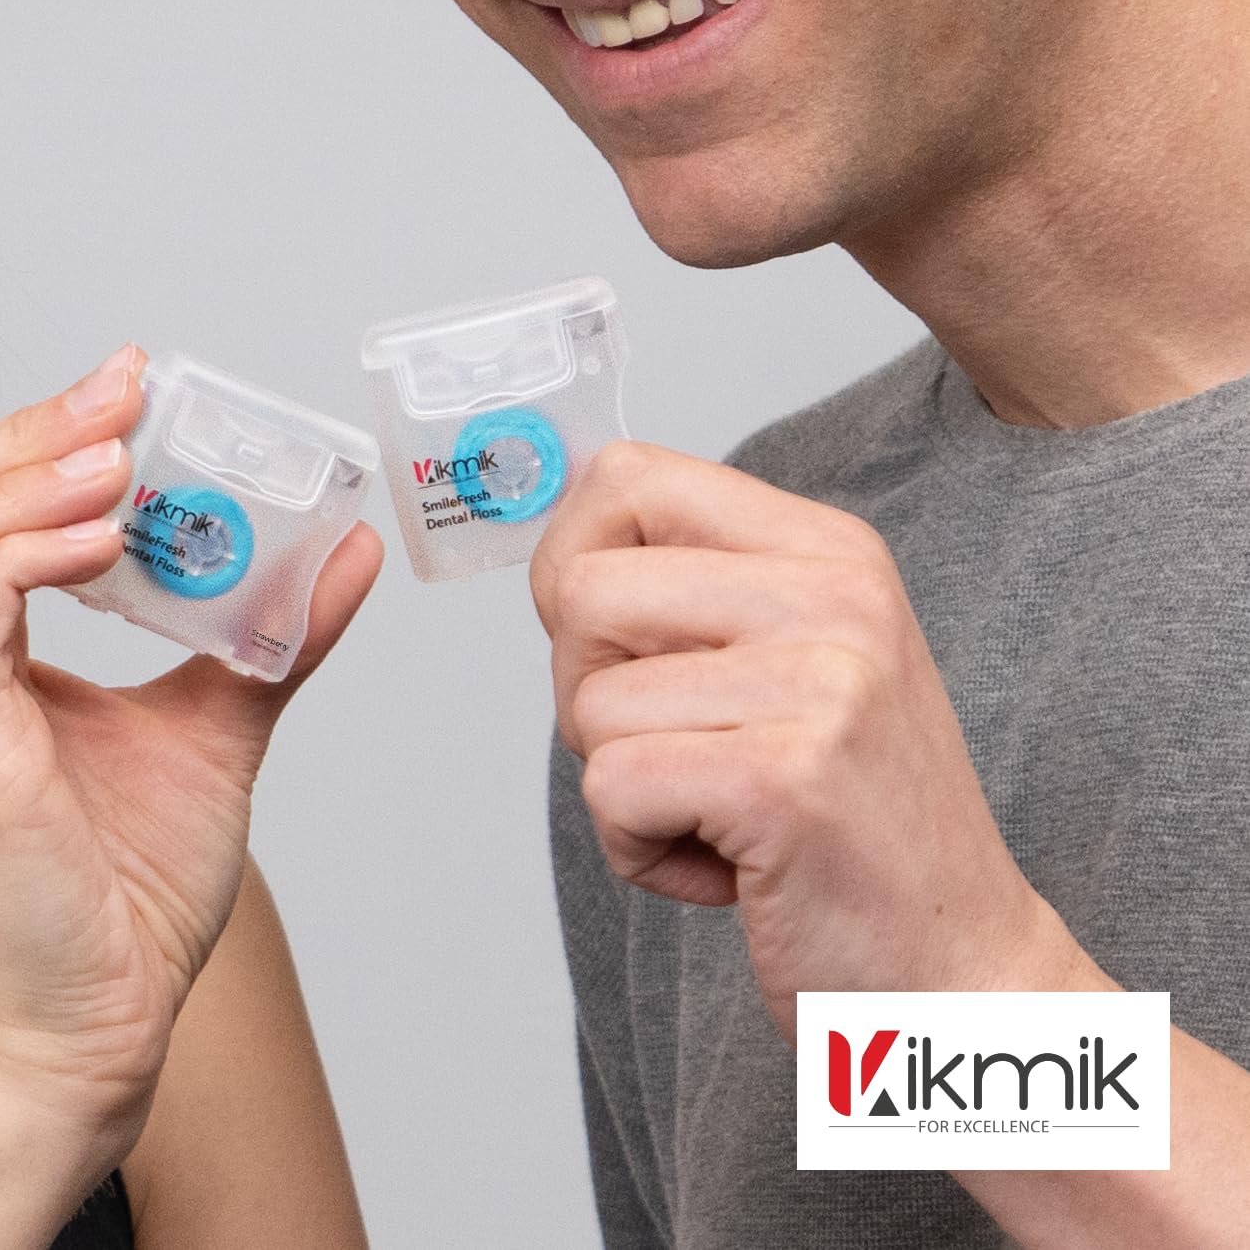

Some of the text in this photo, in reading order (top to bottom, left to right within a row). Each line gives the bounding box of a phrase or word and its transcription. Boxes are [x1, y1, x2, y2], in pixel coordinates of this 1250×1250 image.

[413, 450, 499, 484] Kikmik
[133, 484, 214, 537] Kikmik
[422, 489, 492, 513] SmileFresh
[426, 506, 503, 530] Dental Floss
[122, 522, 186, 559] SmileFresh
[123, 541, 186, 578] ental Floss
